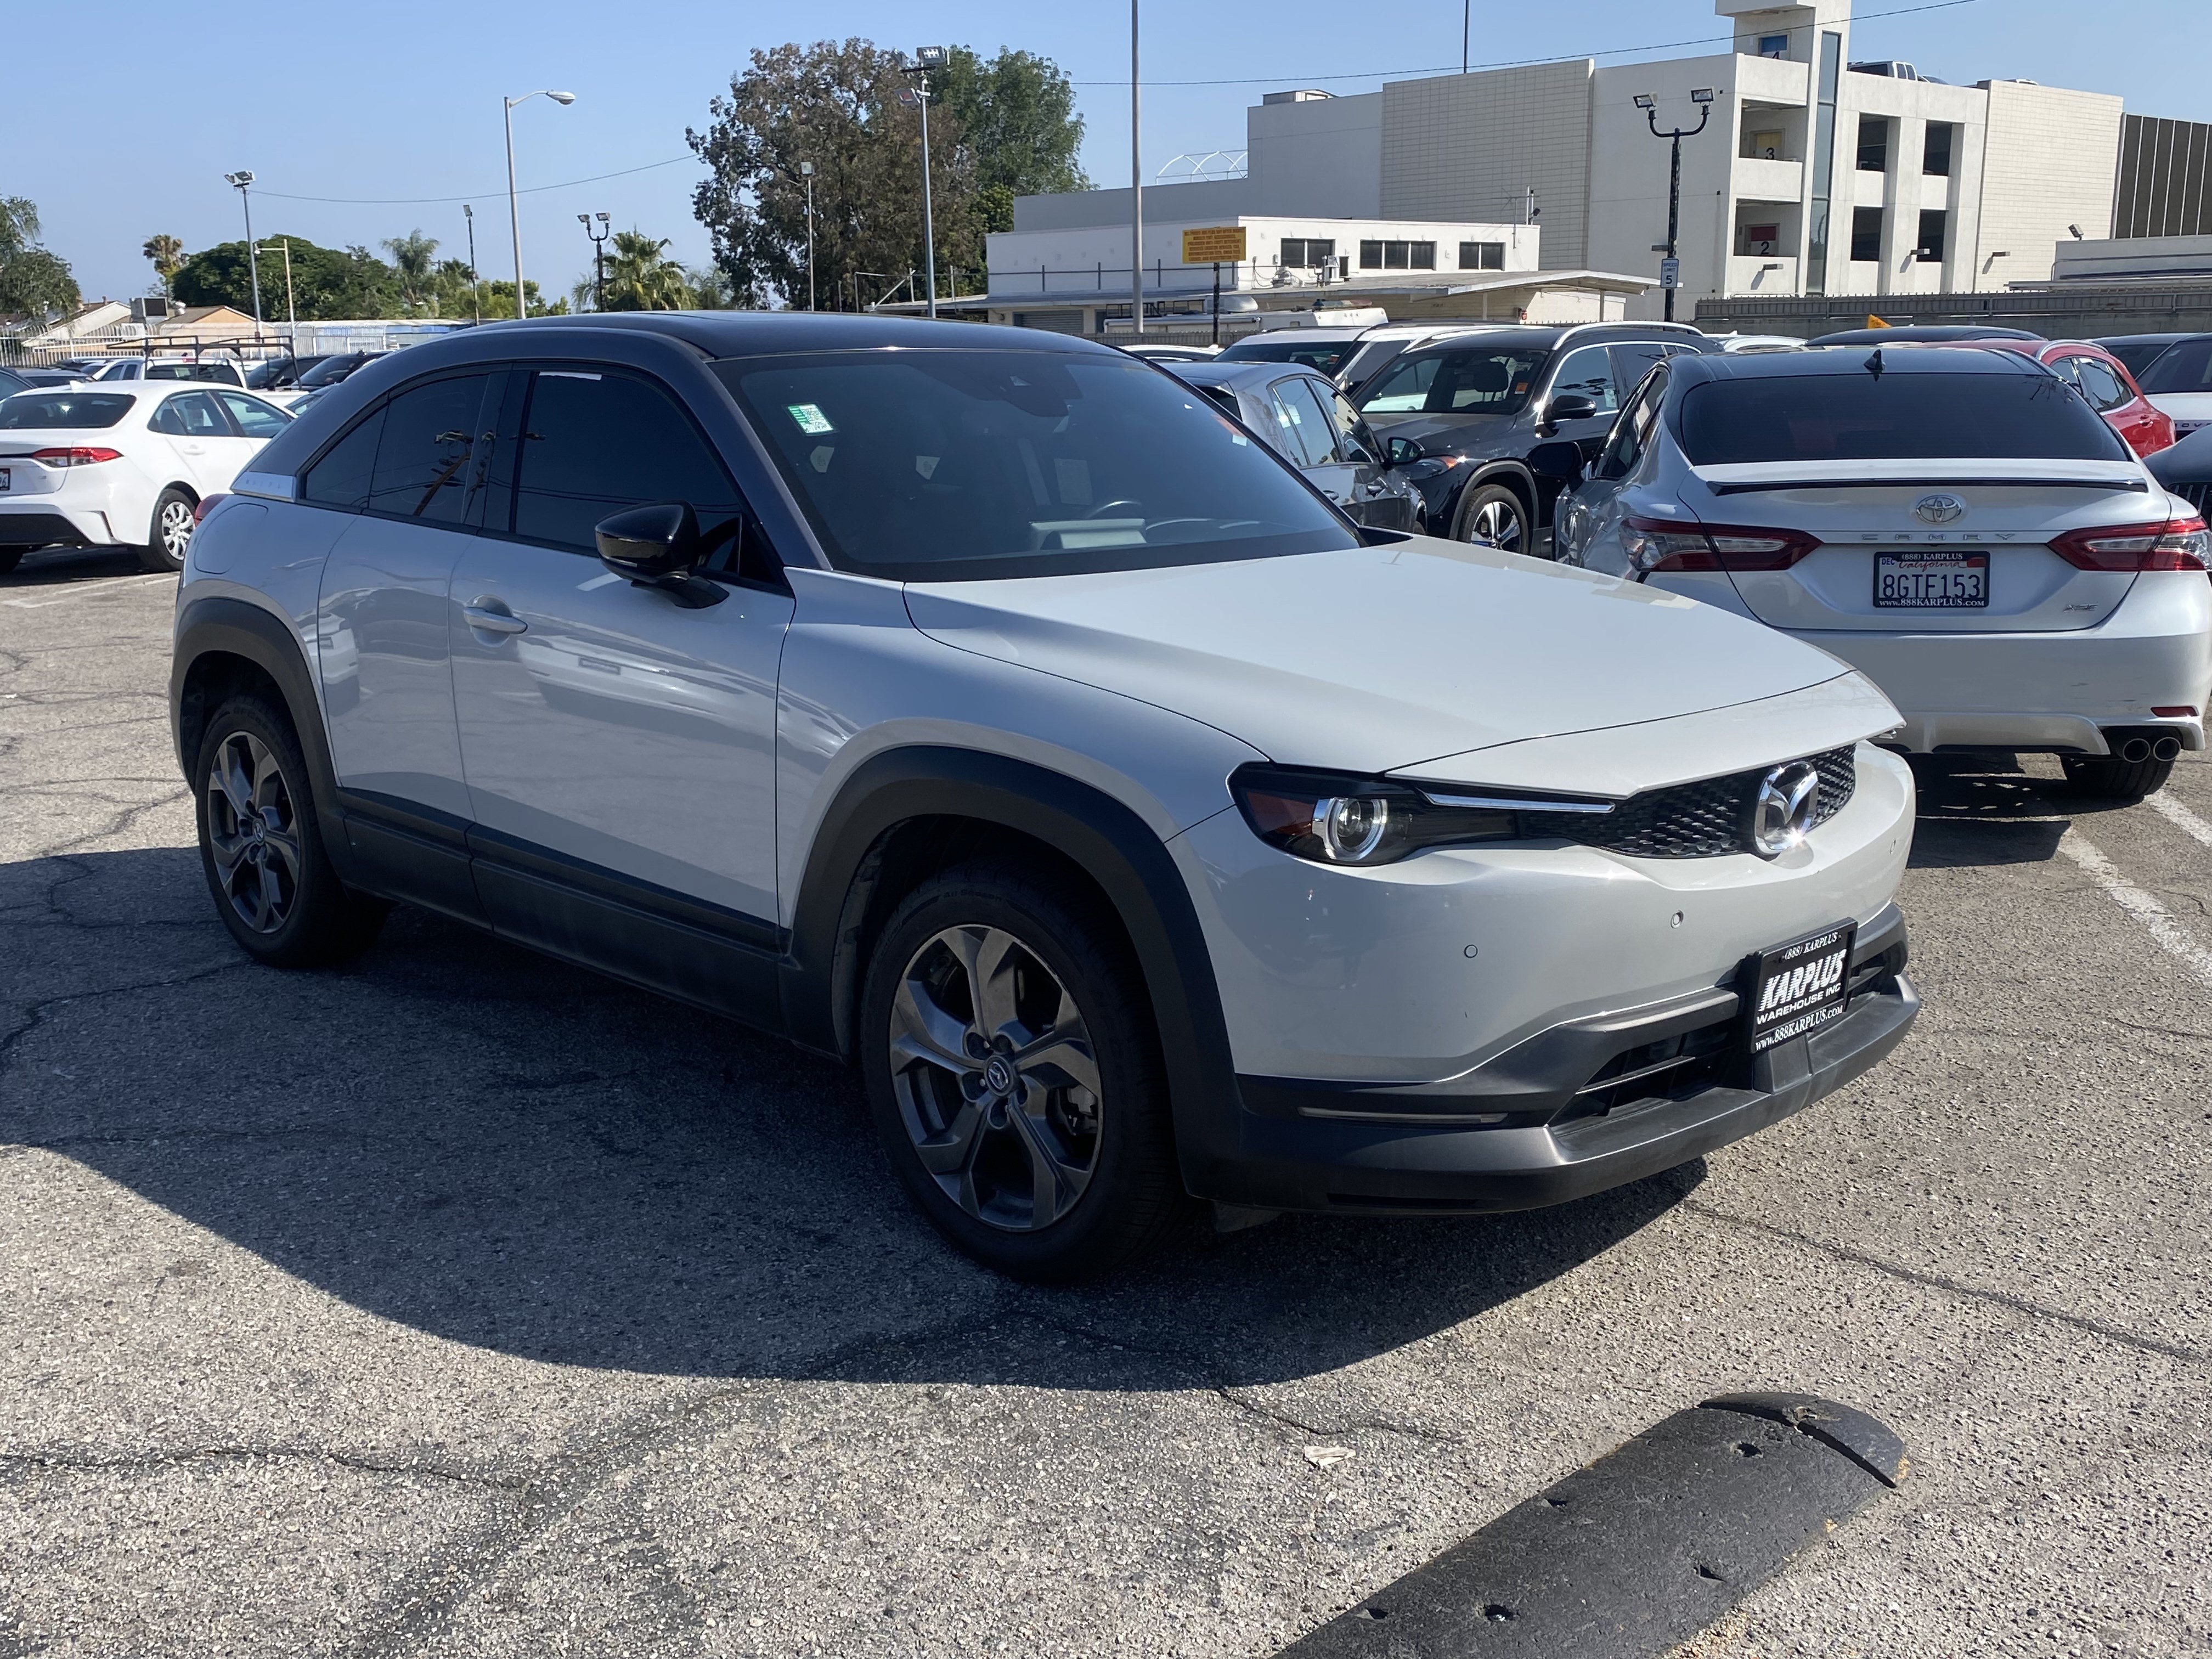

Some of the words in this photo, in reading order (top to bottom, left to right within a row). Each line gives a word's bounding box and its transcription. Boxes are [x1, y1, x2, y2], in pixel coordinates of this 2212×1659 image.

[1765, 147, 1775, 160] 3
[1760, 241, 1769, 255] 2
[1666, 275, 1673, 285] 5
[1881, 557, 1895, 566] DEC
[1883, 574, 1980, 598] 8GTF153
[1784, 946, 1803, 960] (888)
[1803, 932, 1838, 954] KARPLUS
[1758, 949, 1847, 1012] KARPLUS
[1756, 992, 1823, 1025] WAREHOUSE
[1825, 983, 1842, 997] INC
